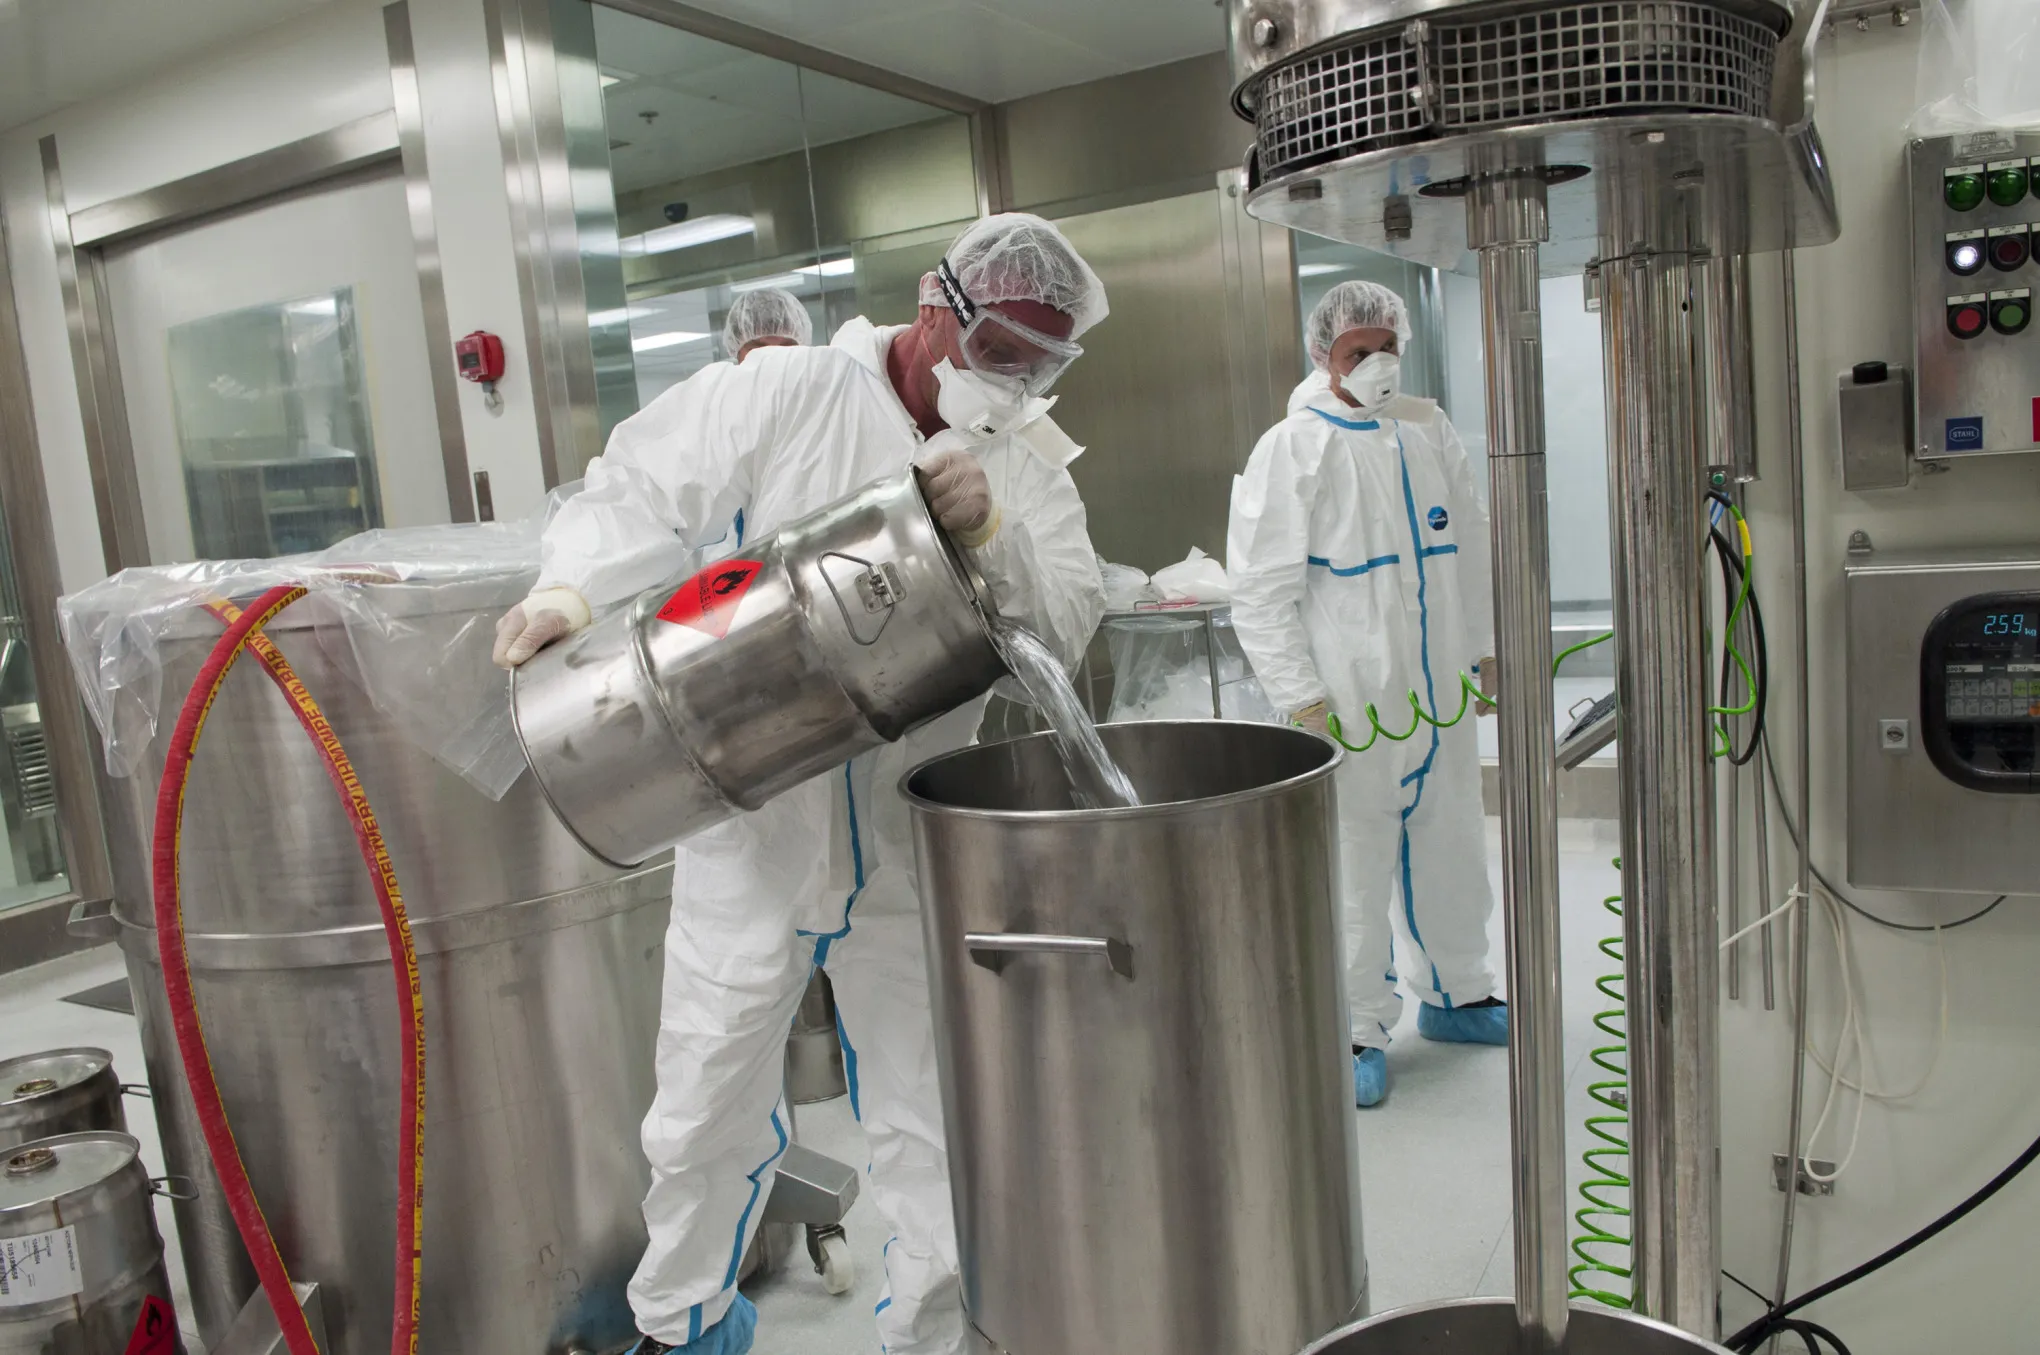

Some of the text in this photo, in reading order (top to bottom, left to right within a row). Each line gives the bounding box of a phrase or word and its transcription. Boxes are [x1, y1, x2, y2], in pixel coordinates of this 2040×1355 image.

[982, 425, 996, 435] 3M
[663, 607, 674, 617] 3
[2025, 627, 2038, 637] kg
[266, 650, 299, 683] BAR
[352, 795, 398, 889] DELIVERY
[395, 904, 421, 995] SUCTION
